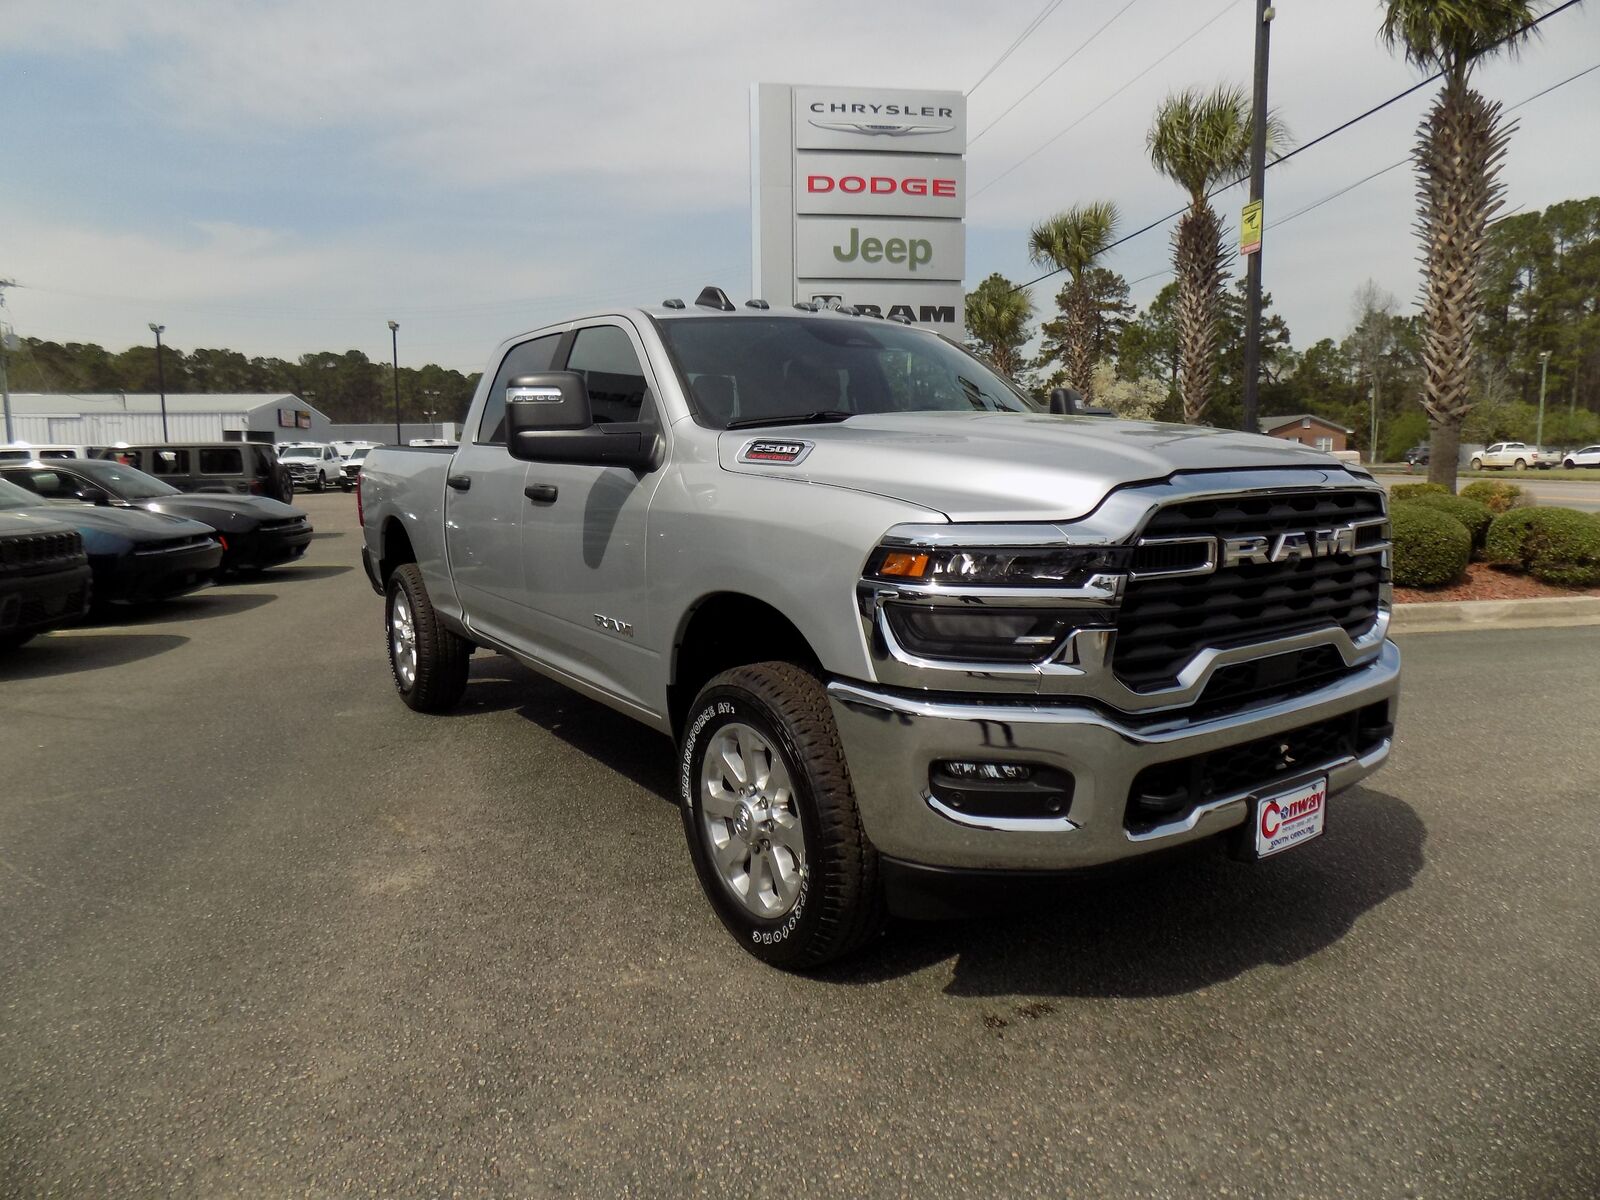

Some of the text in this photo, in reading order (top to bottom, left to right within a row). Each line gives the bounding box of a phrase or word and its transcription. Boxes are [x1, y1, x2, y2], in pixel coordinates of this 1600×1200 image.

[810, 102, 953, 118] CHRYSLER
[807, 175, 956, 198] DODGE
[833, 227, 933, 271] Jeep
[753, 444, 800, 453] 2500
[1223, 528, 1354, 568] RAM
[681, 705, 716, 798] TRANSFORCE
